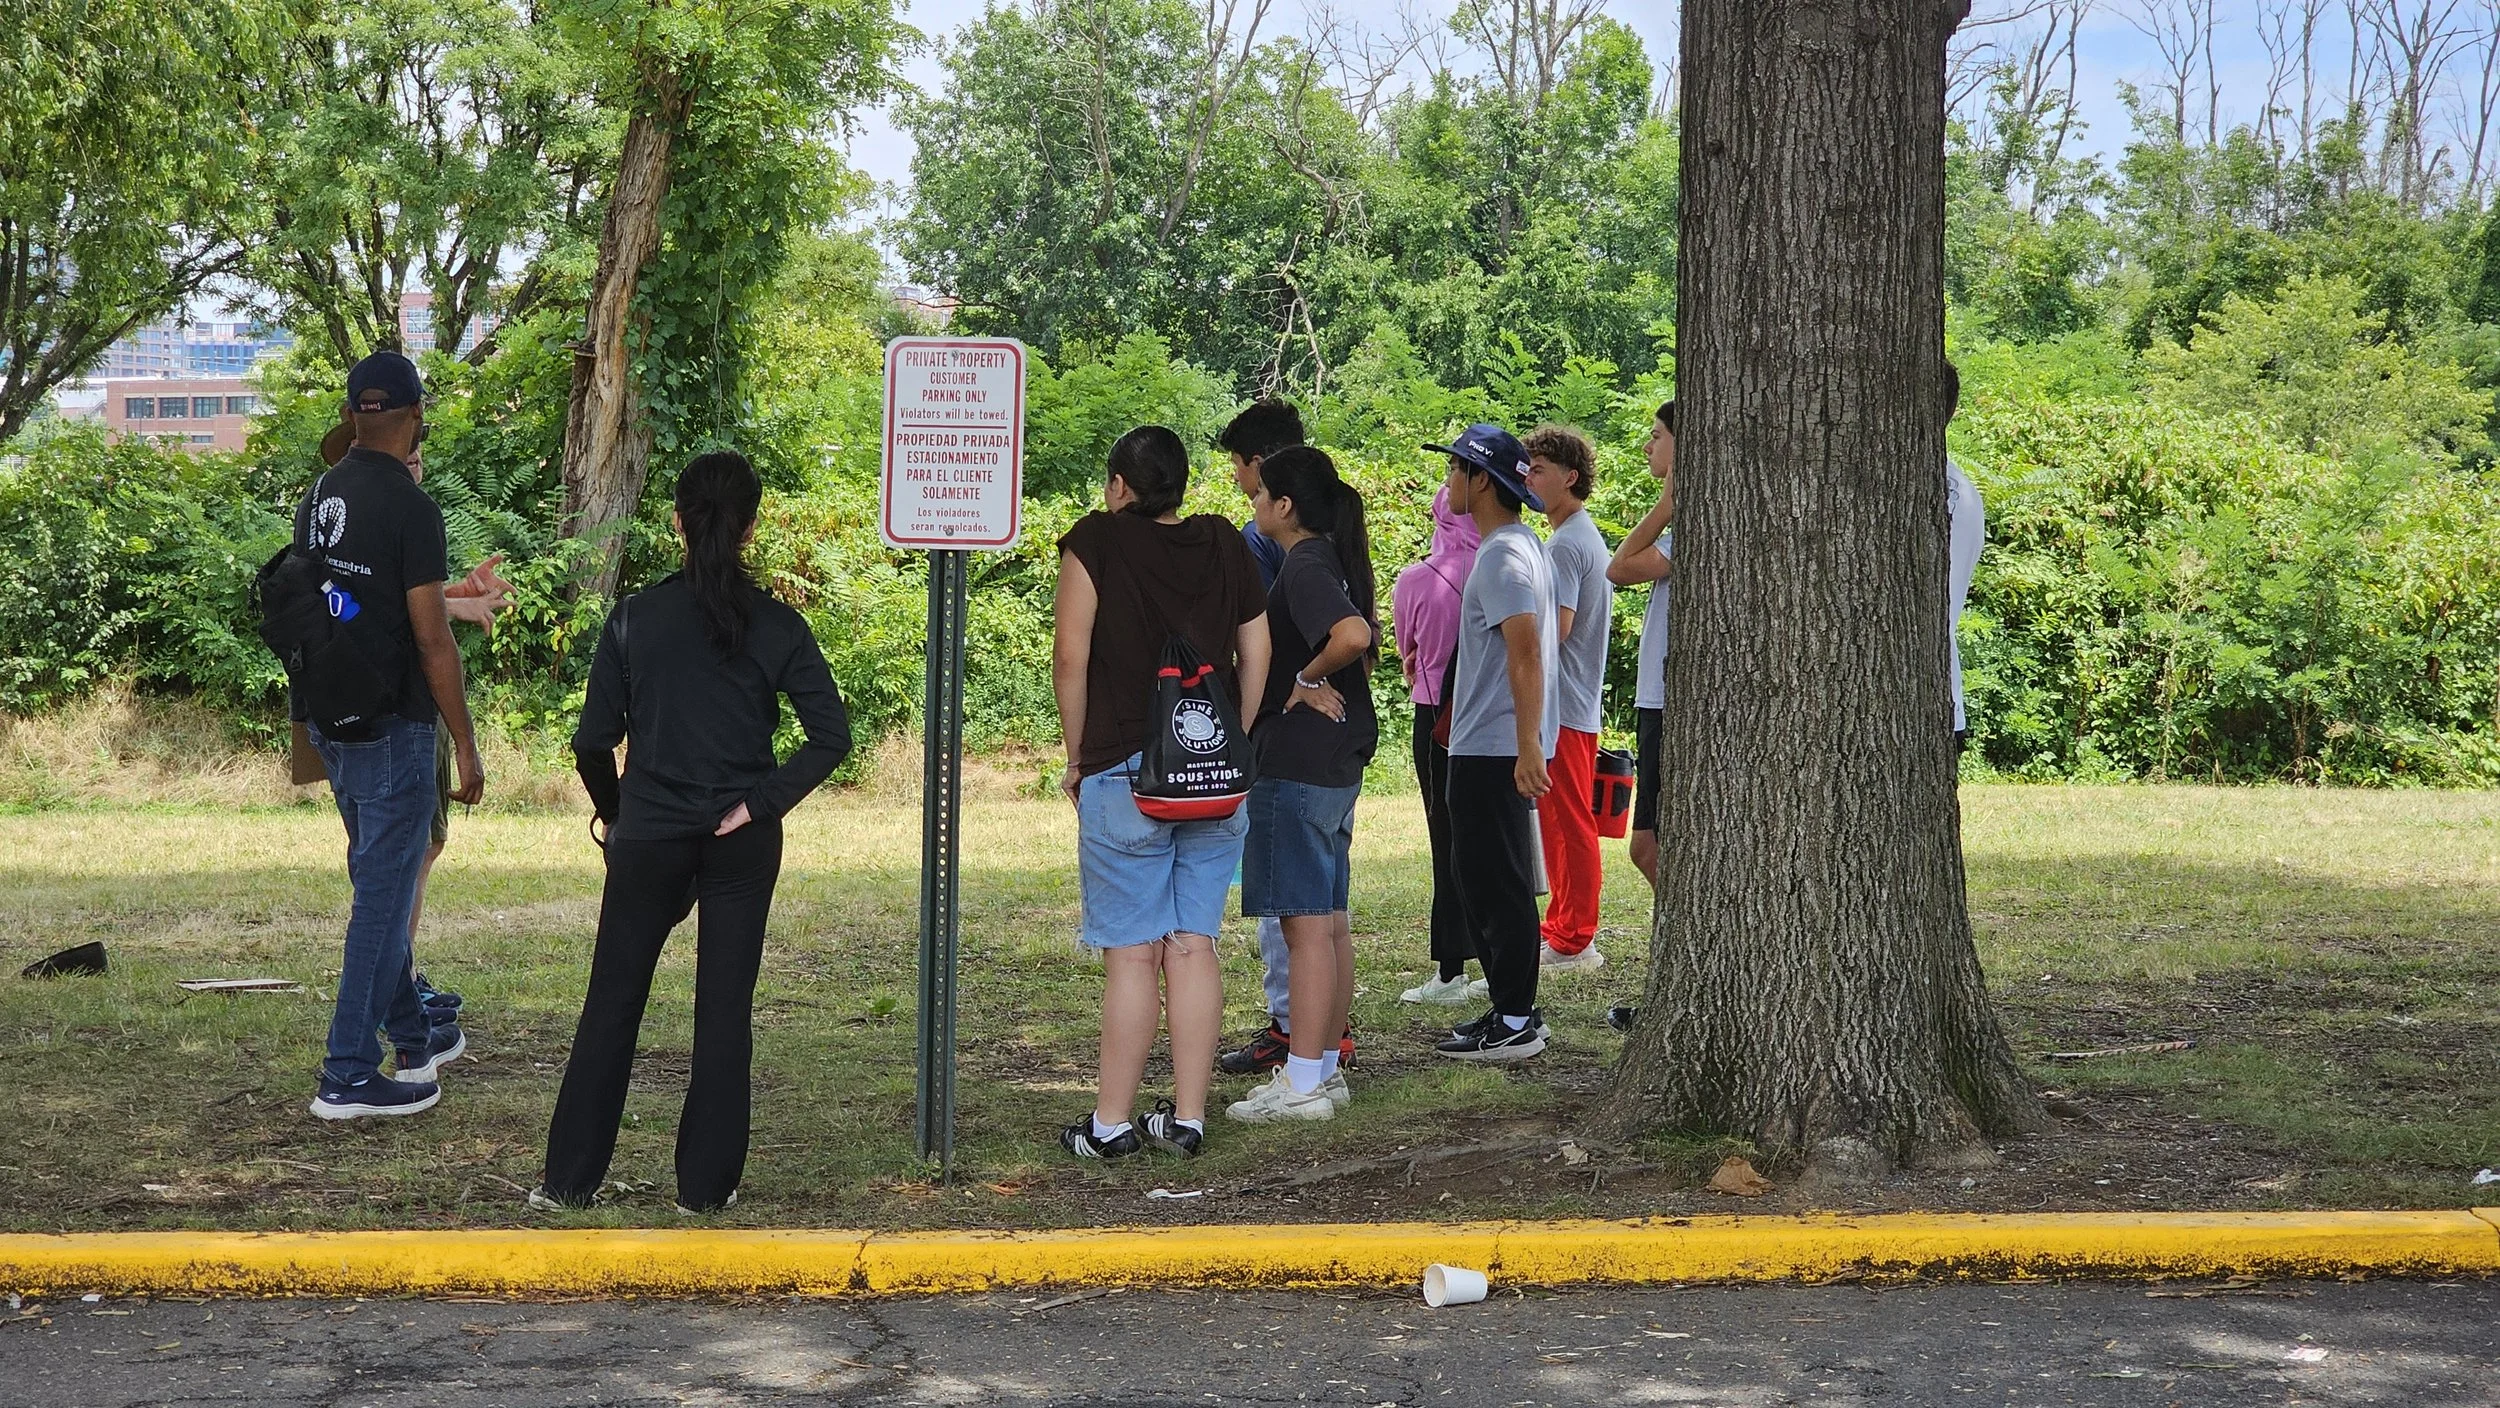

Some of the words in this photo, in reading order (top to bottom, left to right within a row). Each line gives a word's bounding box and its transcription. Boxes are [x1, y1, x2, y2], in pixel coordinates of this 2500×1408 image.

[906, 351, 947, 367] PRIVATE
[952, 352, 1006, 368] PROPERTY
[930, 372, 977, 385] CUSTOMER
[922, 389, 961, 402] PARKING
[965, 390, 987, 403] ONLY
[900, 407, 941, 419] Violators
[945, 408, 960, 420] will
[964, 408, 974, 420] be
[979, 409, 1008, 420] towed.
[896, 433, 958, 447] PROPIEDAD
[963, 434, 1010, 448] PRIVADA
[907, 451, 998, 465] ESTACIONAMIENTO
[906, 469, 932, 481] PARA
[937, 469, 948, 482] EL
[953, 470, 993, 483] CLIENTE
[922, 486, 980, 500] SOLAMENTE
[917, 507, 931, 517] Los
[936, 507, 980, 518] violadores
[911, 523, 934, 531] seran
